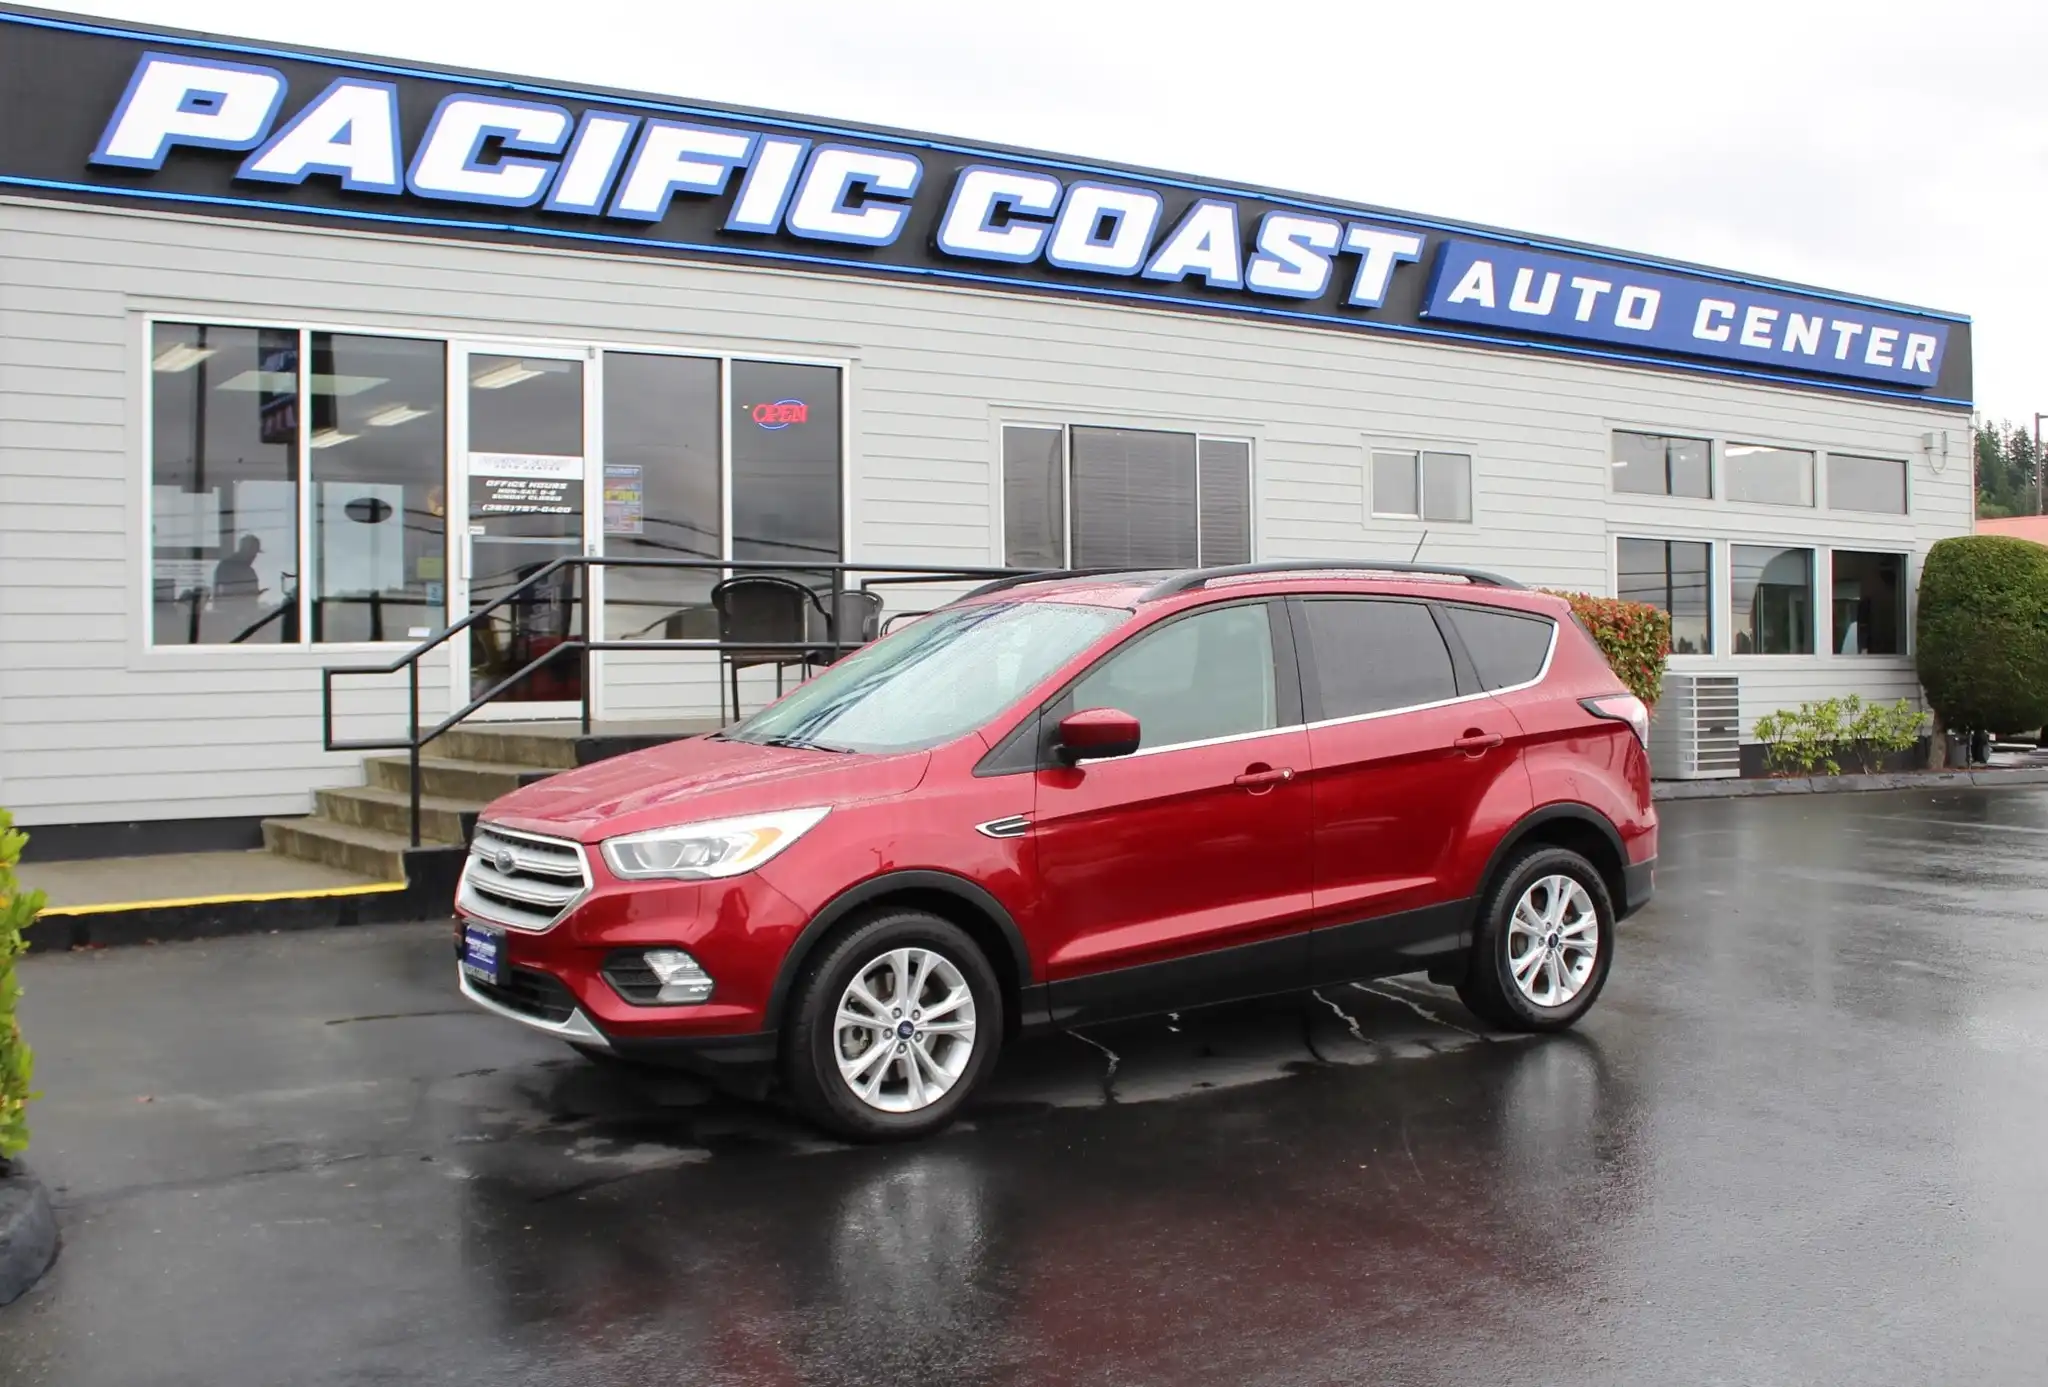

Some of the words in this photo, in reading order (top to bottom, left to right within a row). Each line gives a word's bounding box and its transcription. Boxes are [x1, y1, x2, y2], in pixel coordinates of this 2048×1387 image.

[90, 51, 924, 246] PACIFIC
[938, 164, 1426, 308] COAST
[1448, 261, 1661, 331] AUTO
[1692, 299, 1937, 373] CENTER
[753, 404, 808, 423] OPEN
[485, 480, 527, 488] OFFICE
